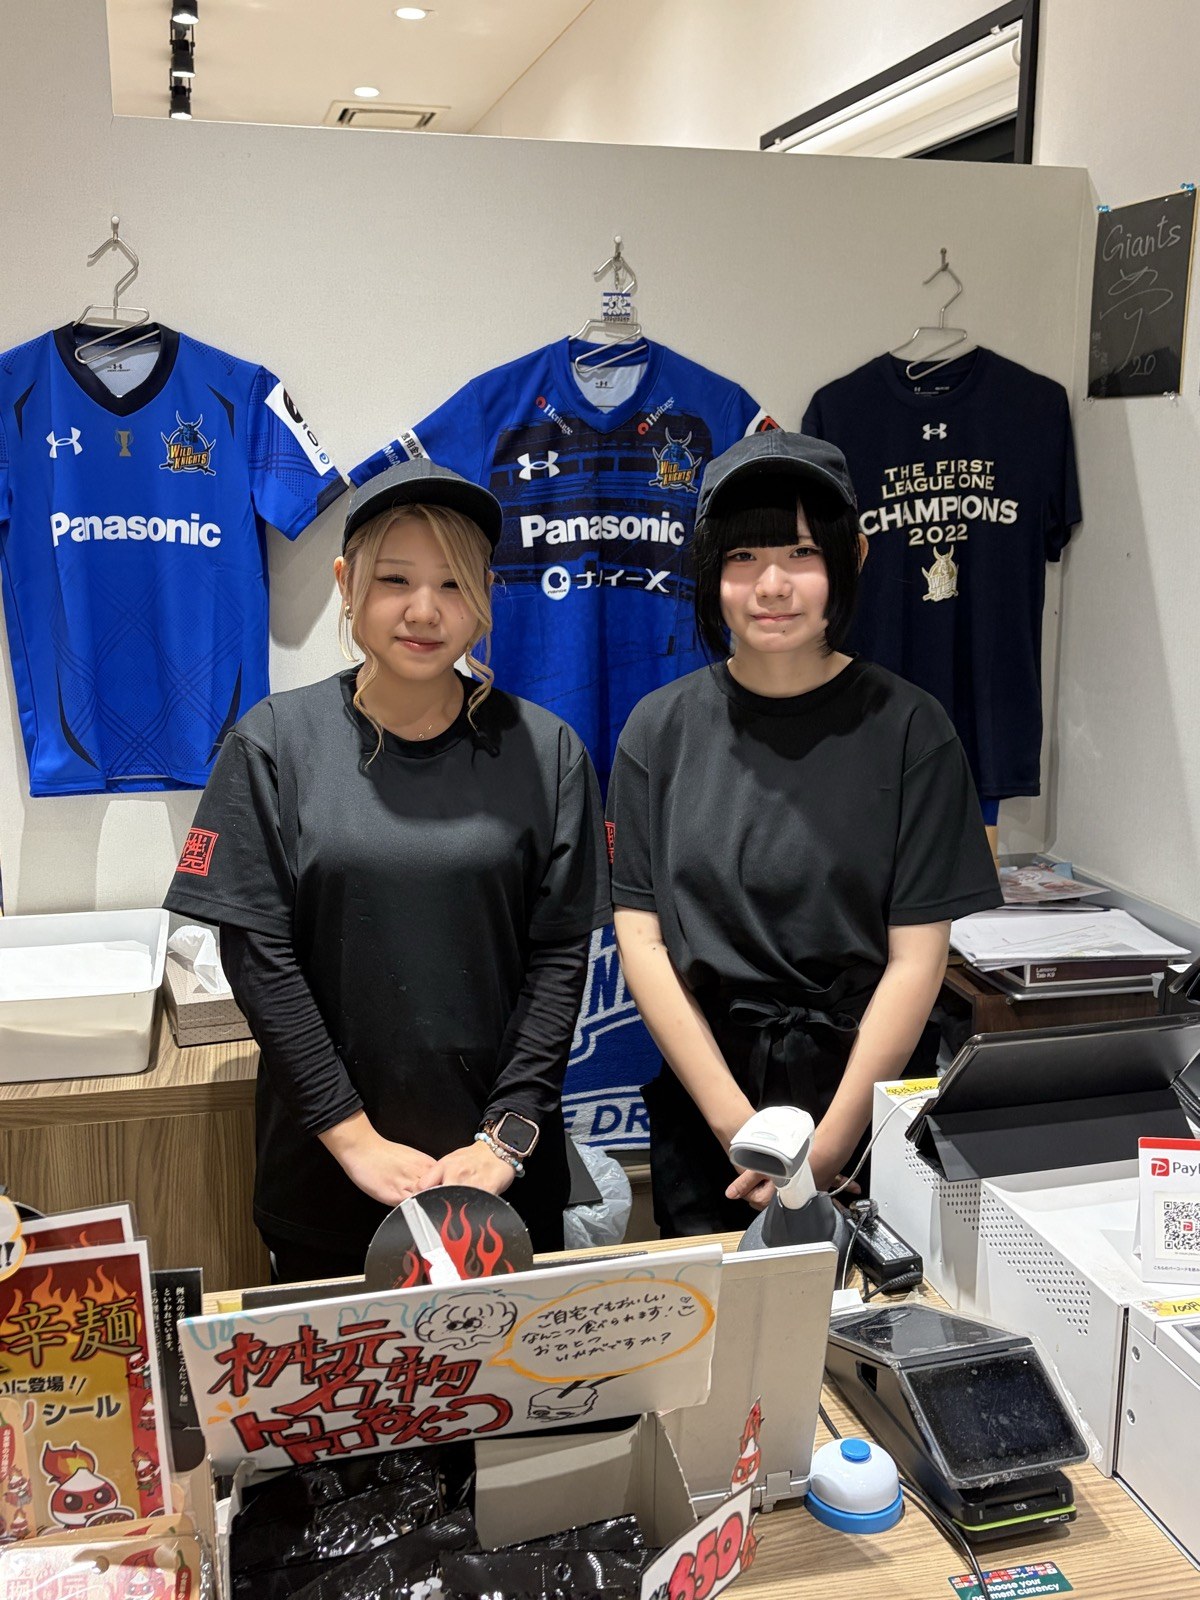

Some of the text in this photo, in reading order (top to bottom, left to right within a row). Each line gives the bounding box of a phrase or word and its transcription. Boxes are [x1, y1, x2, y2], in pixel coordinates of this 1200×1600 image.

[1103, 216, 1181, 261] Giants
[1129, 354, 1156, 377] 20
[543, 404, 573, 436] Heritage
[648, 397, 675, 426] Heritage
[174, 453, 207, 469] KNIGHTS
[884, 460, 995, 481] THE FIRST
[881, 474, 995, 499] LEAGUE ONE
[858, 495, 1019, 536] CHAMPIONS
[50, 512, 222, 548] Panasonic
[519, 511, 685, 548] Panasonic
[909, 524, 968, 546] 2022
[0, 1297, 143, 1369] 辛麺
[534, 1336, 602, 1357] おひとつ
[271, 1346, 481, 1416] 名物
[985, 1578, 1042, 1592] hoose your
[1019, 1583, 1060, 1597] currency
